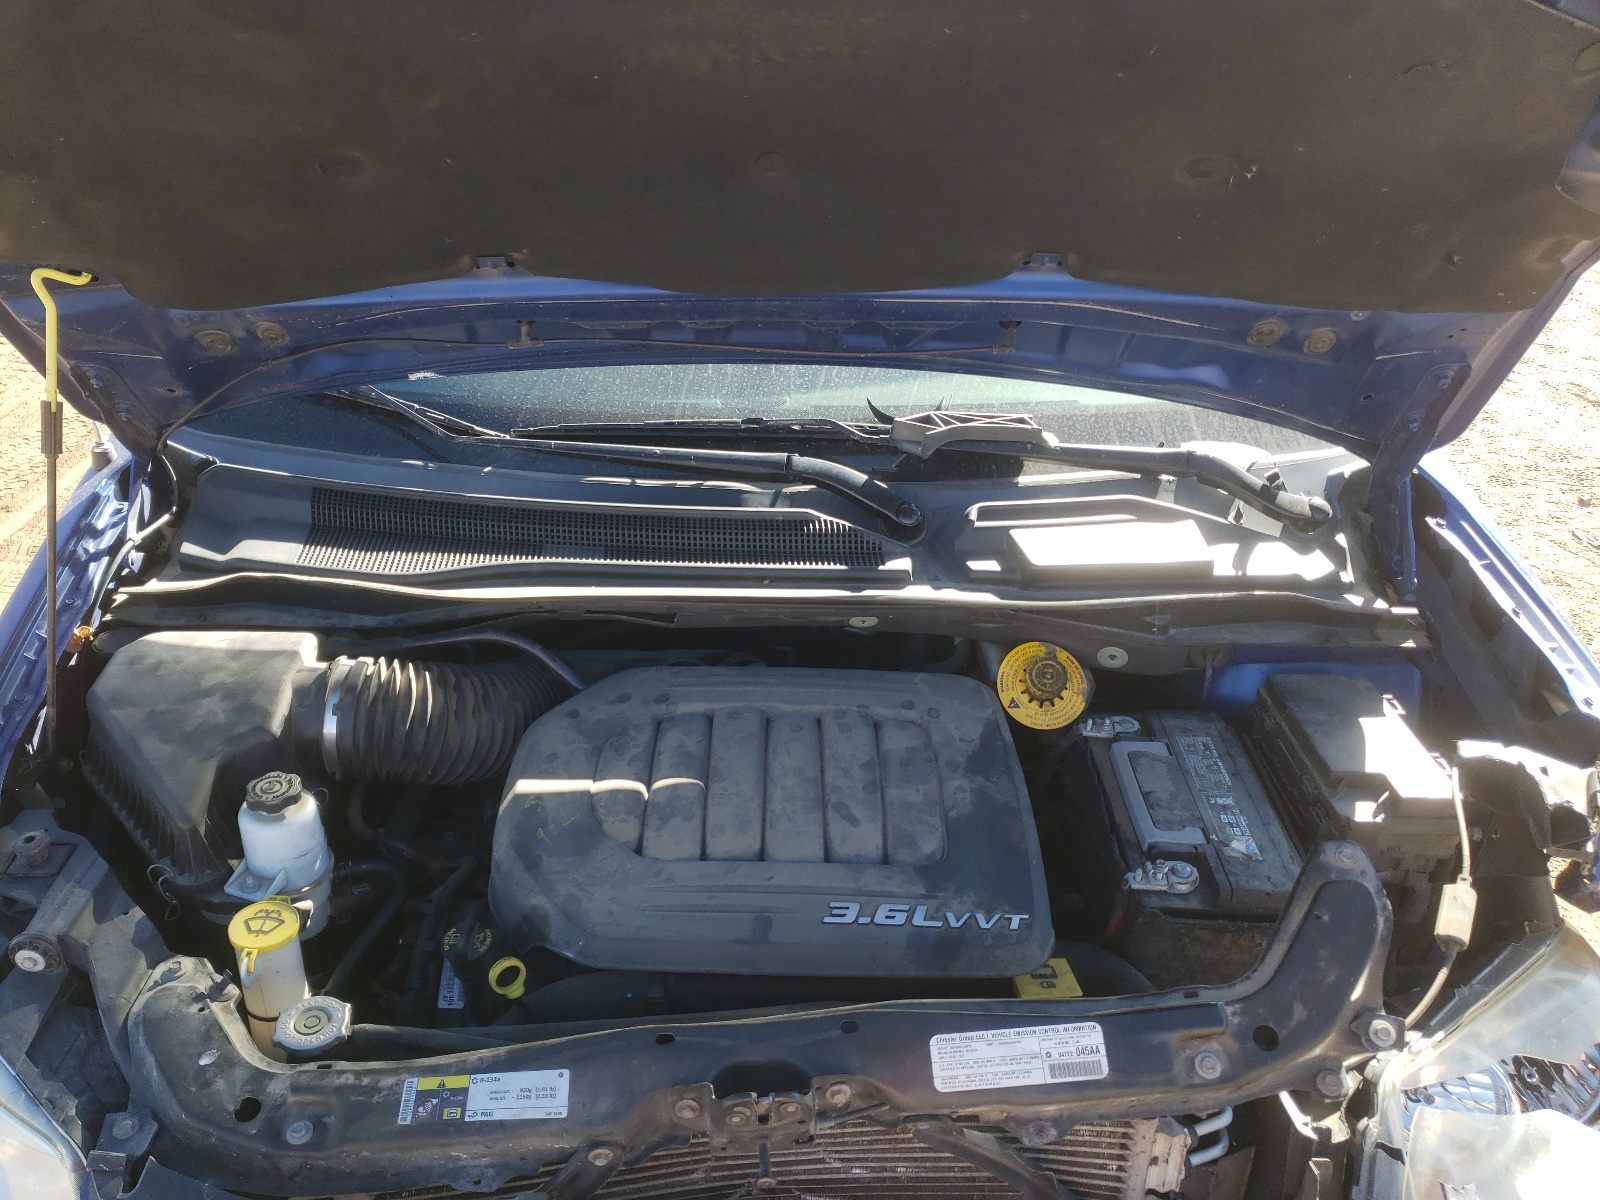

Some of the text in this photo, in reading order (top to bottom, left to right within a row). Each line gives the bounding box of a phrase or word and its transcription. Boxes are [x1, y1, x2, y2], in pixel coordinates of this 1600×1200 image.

[991, 1030, 1012, 1038] VEHICLE
[1013, 1028, 1037, 1037] EMISSION
[1037, 1026, 1061, 1035] CONTROL
[1061, 1024, 1097, 1033] INFORMATION
[1075, 1045, 1101, 1057] 045AA
